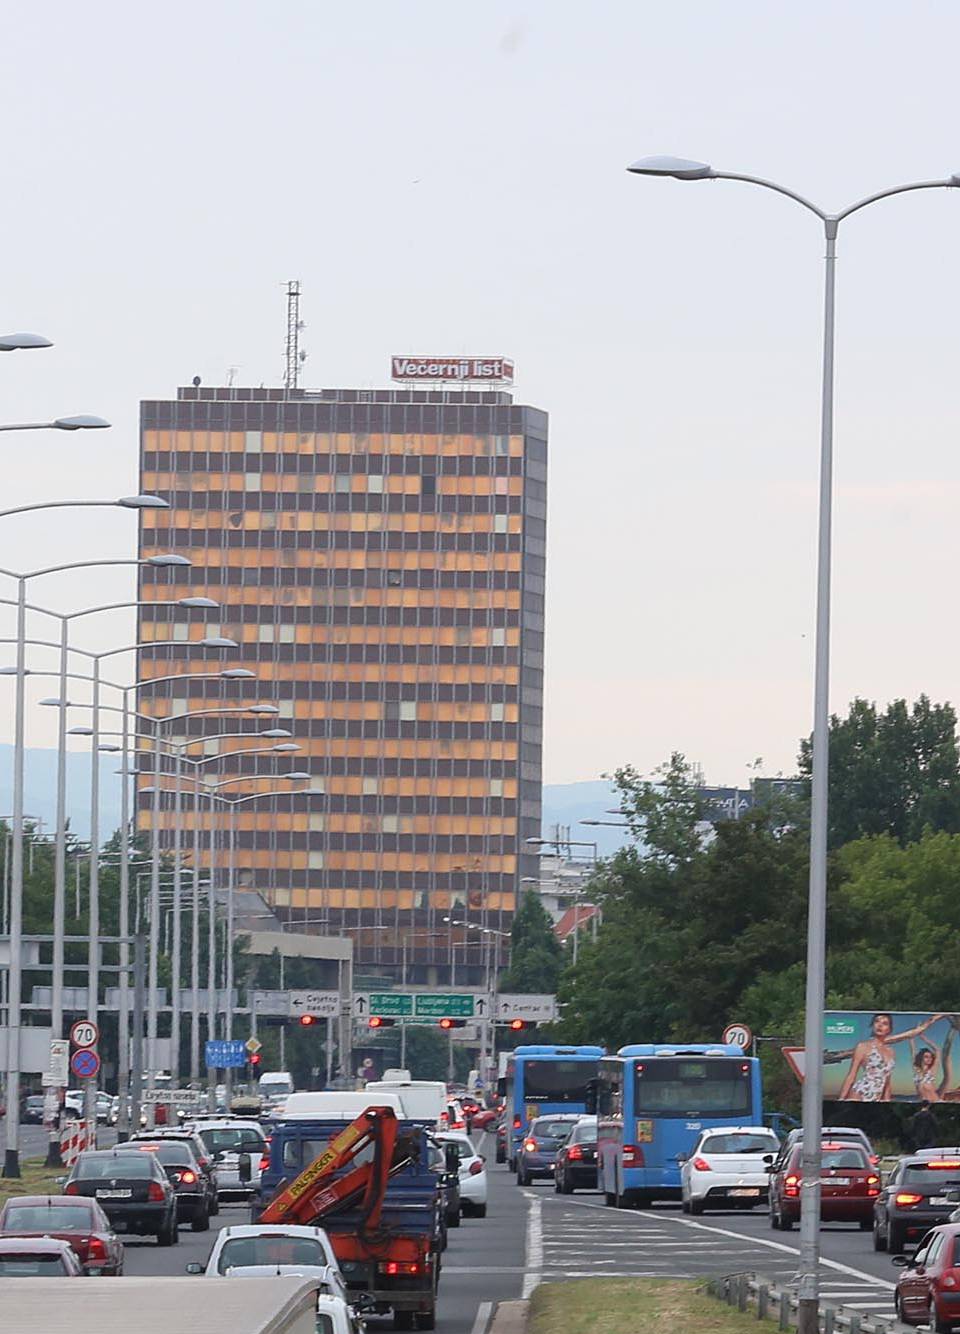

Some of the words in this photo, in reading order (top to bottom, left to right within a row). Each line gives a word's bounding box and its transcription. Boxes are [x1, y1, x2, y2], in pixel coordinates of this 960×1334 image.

[393, 359, 469, 379] Večernji
[473, 361, 503, 377] list
[76, 1028, 93, 1041] 70
[728, 1031, 745, 1045] 70
